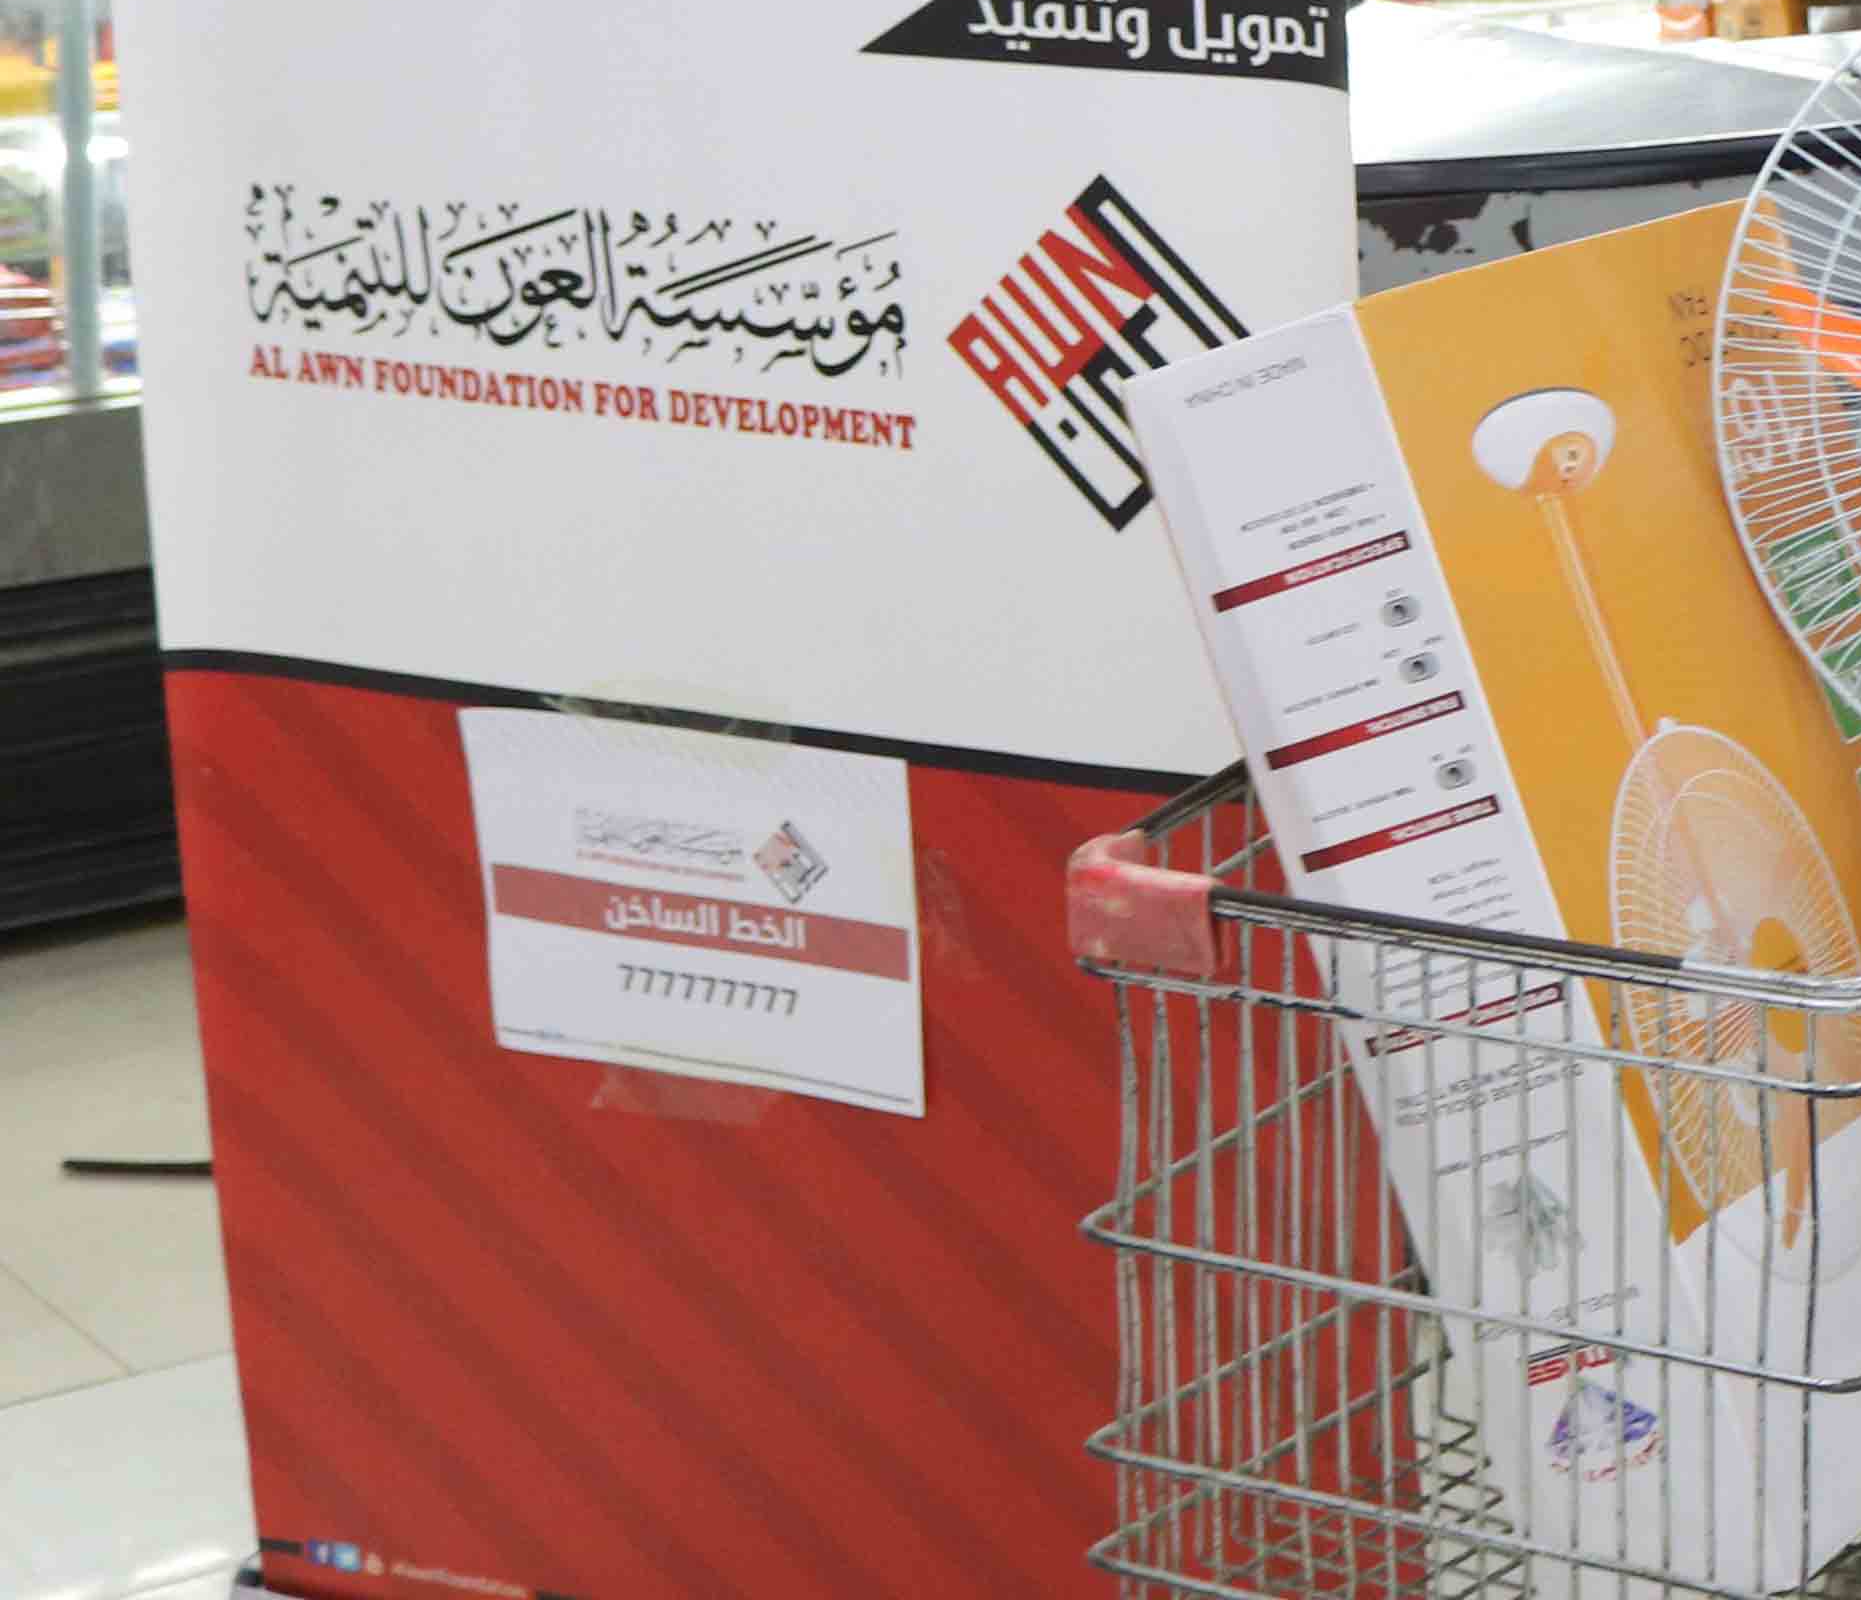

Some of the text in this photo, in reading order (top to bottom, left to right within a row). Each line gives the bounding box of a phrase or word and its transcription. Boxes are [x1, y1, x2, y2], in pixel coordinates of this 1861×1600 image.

[249, 344, 917, 449] AL AWN FOUNDATION FOR DEVELOPMENT
[604, 895, 807, 951] الخط الساخن
